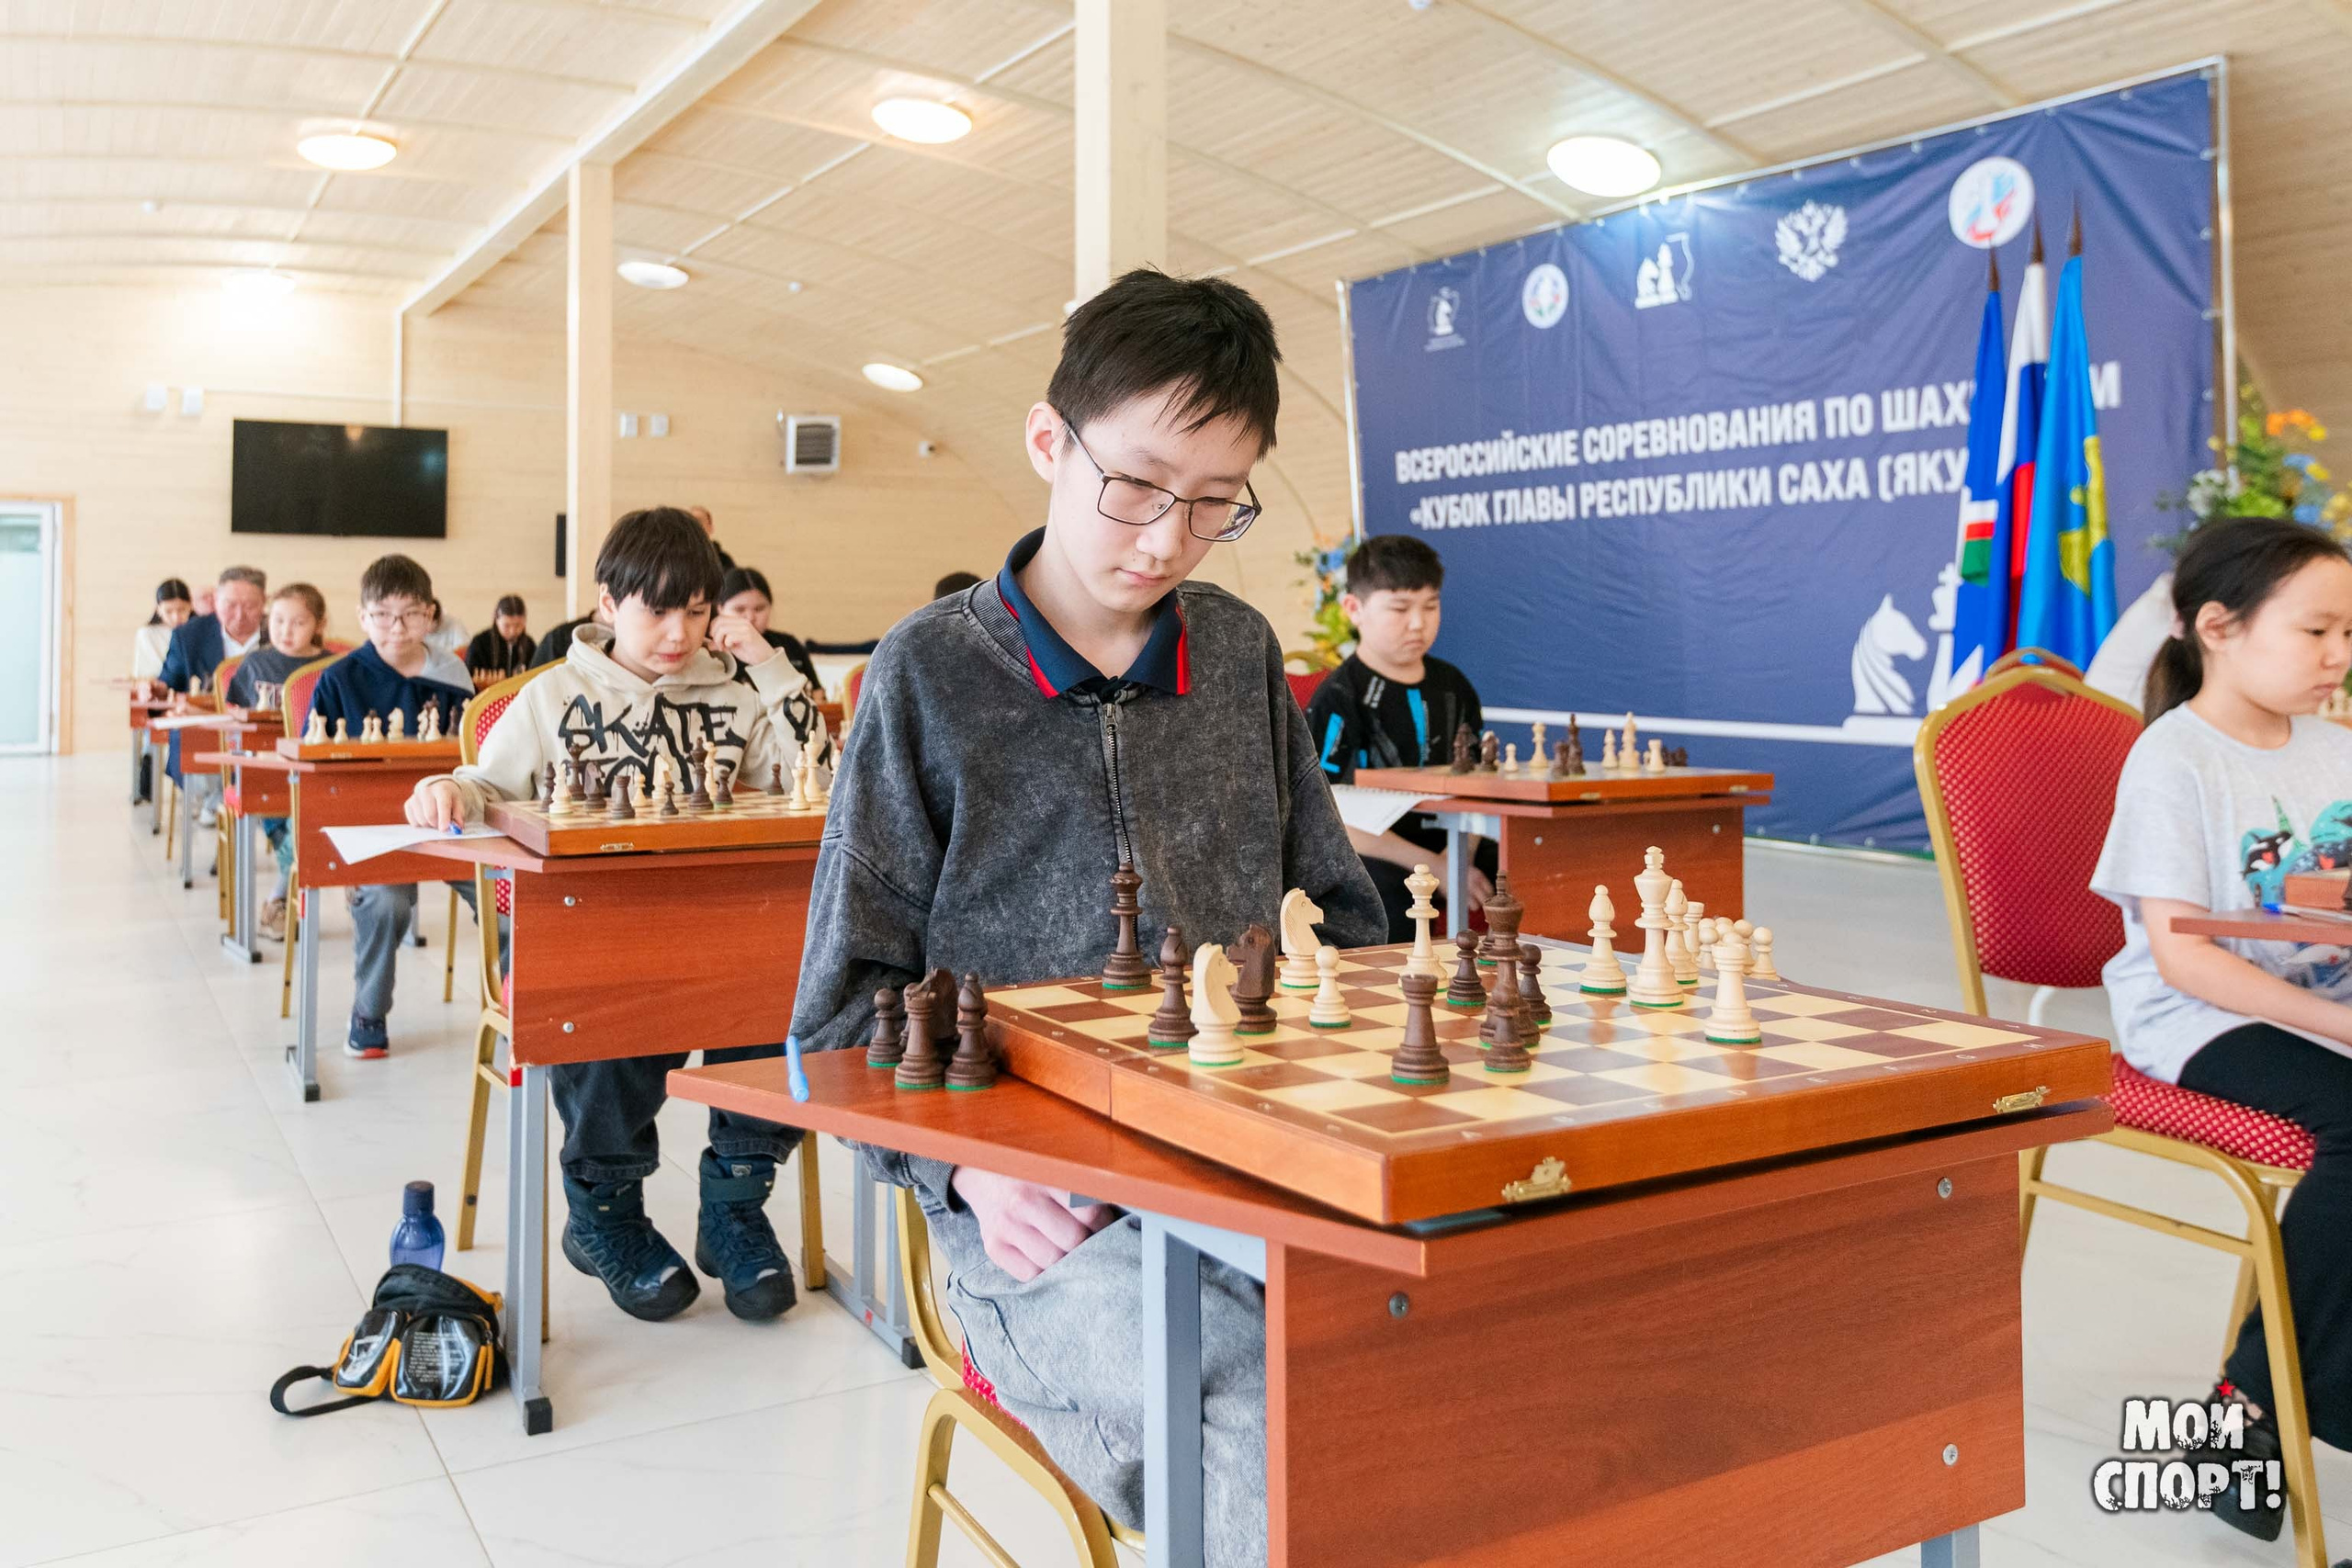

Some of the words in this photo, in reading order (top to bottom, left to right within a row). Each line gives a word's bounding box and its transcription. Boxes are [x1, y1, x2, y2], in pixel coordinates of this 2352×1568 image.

[1395, 429, 1579, 484] ВСЕРОССИЙСКИЕ
[1582, 400, 1817, 463] СОРЕВНОВАНИЯ
[1824, 392, 1874, 439] ПО
[1409, 491, 1491, 530] «КУБОК
[1492, 483, 1577, 525] ГЛАВЫ
[1579, 466, 1771, 519] РЕСПУБЛИКИ
[1778, 457, 1871, 504] САХА
[559, 692, 747, 759] SKATE
